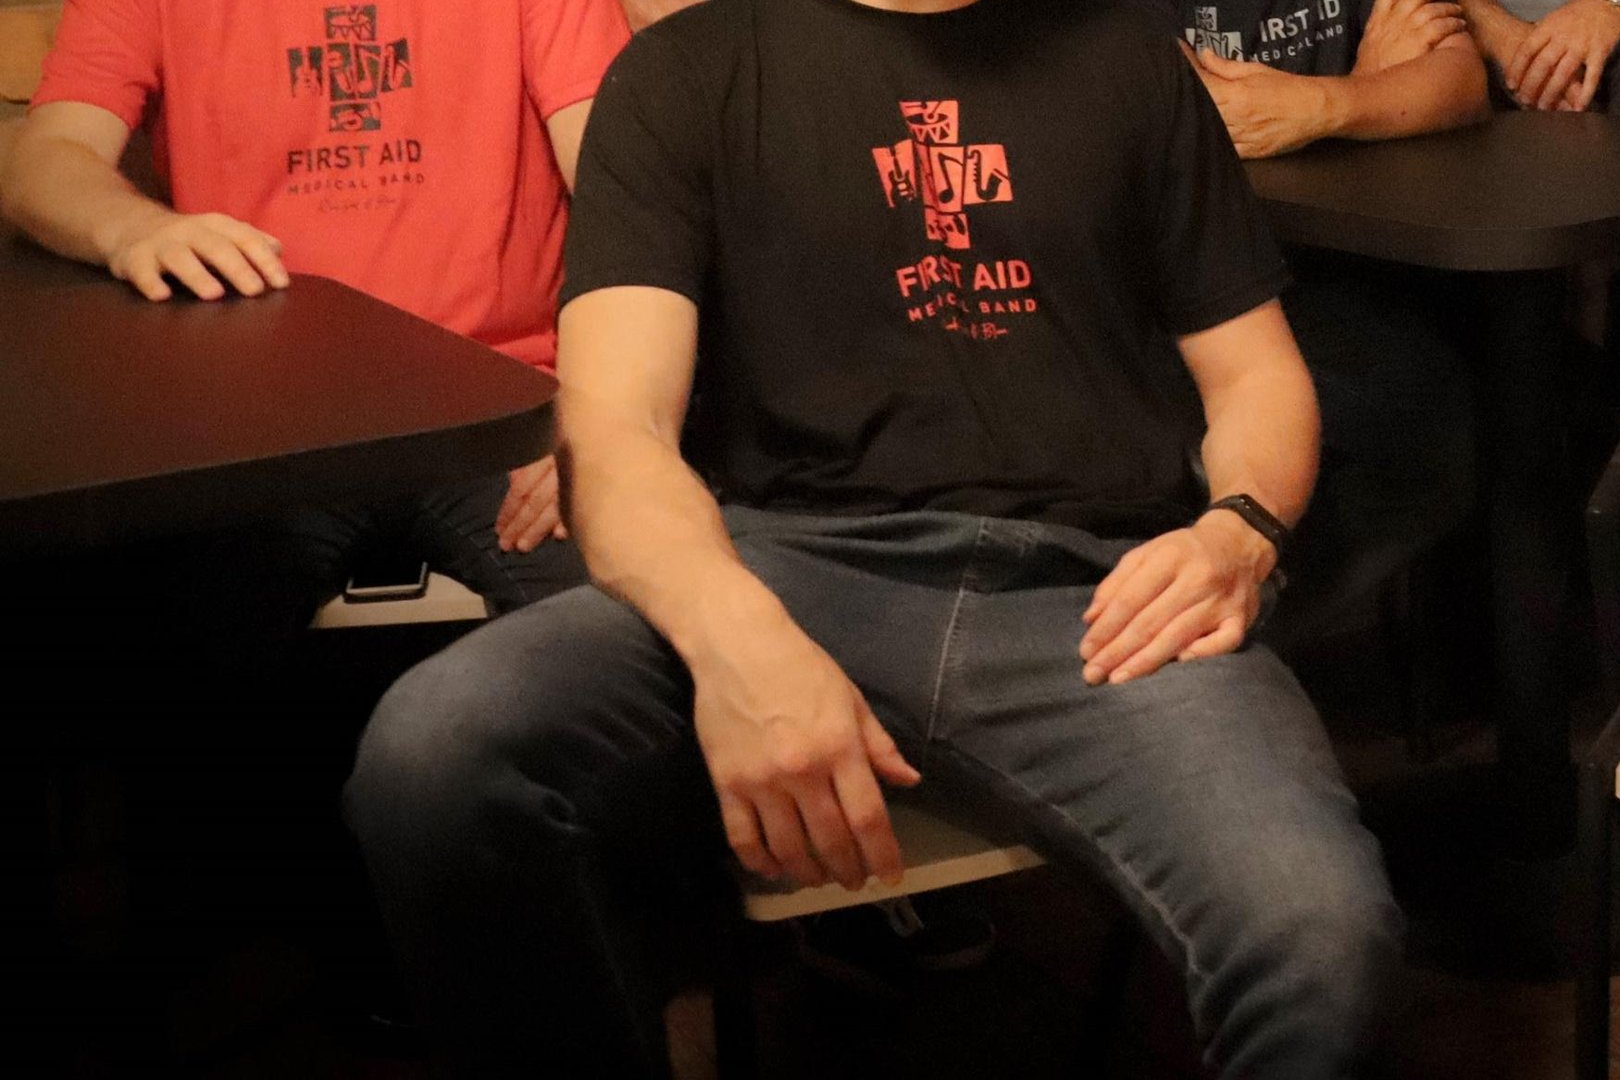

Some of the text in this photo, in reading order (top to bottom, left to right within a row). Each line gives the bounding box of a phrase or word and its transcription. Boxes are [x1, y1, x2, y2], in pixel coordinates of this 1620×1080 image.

[1260, 8, 1310, 43] IRST
[1250, 24, 1344, 63] MEDCAL AND
[287, 138, 422, 174] FIRST AID
[287, 172, 425, 195] MEDICAL BAND
[896, 255, 1031, 297] FIRST AID
[979, 298, 1037, 314] BAND
